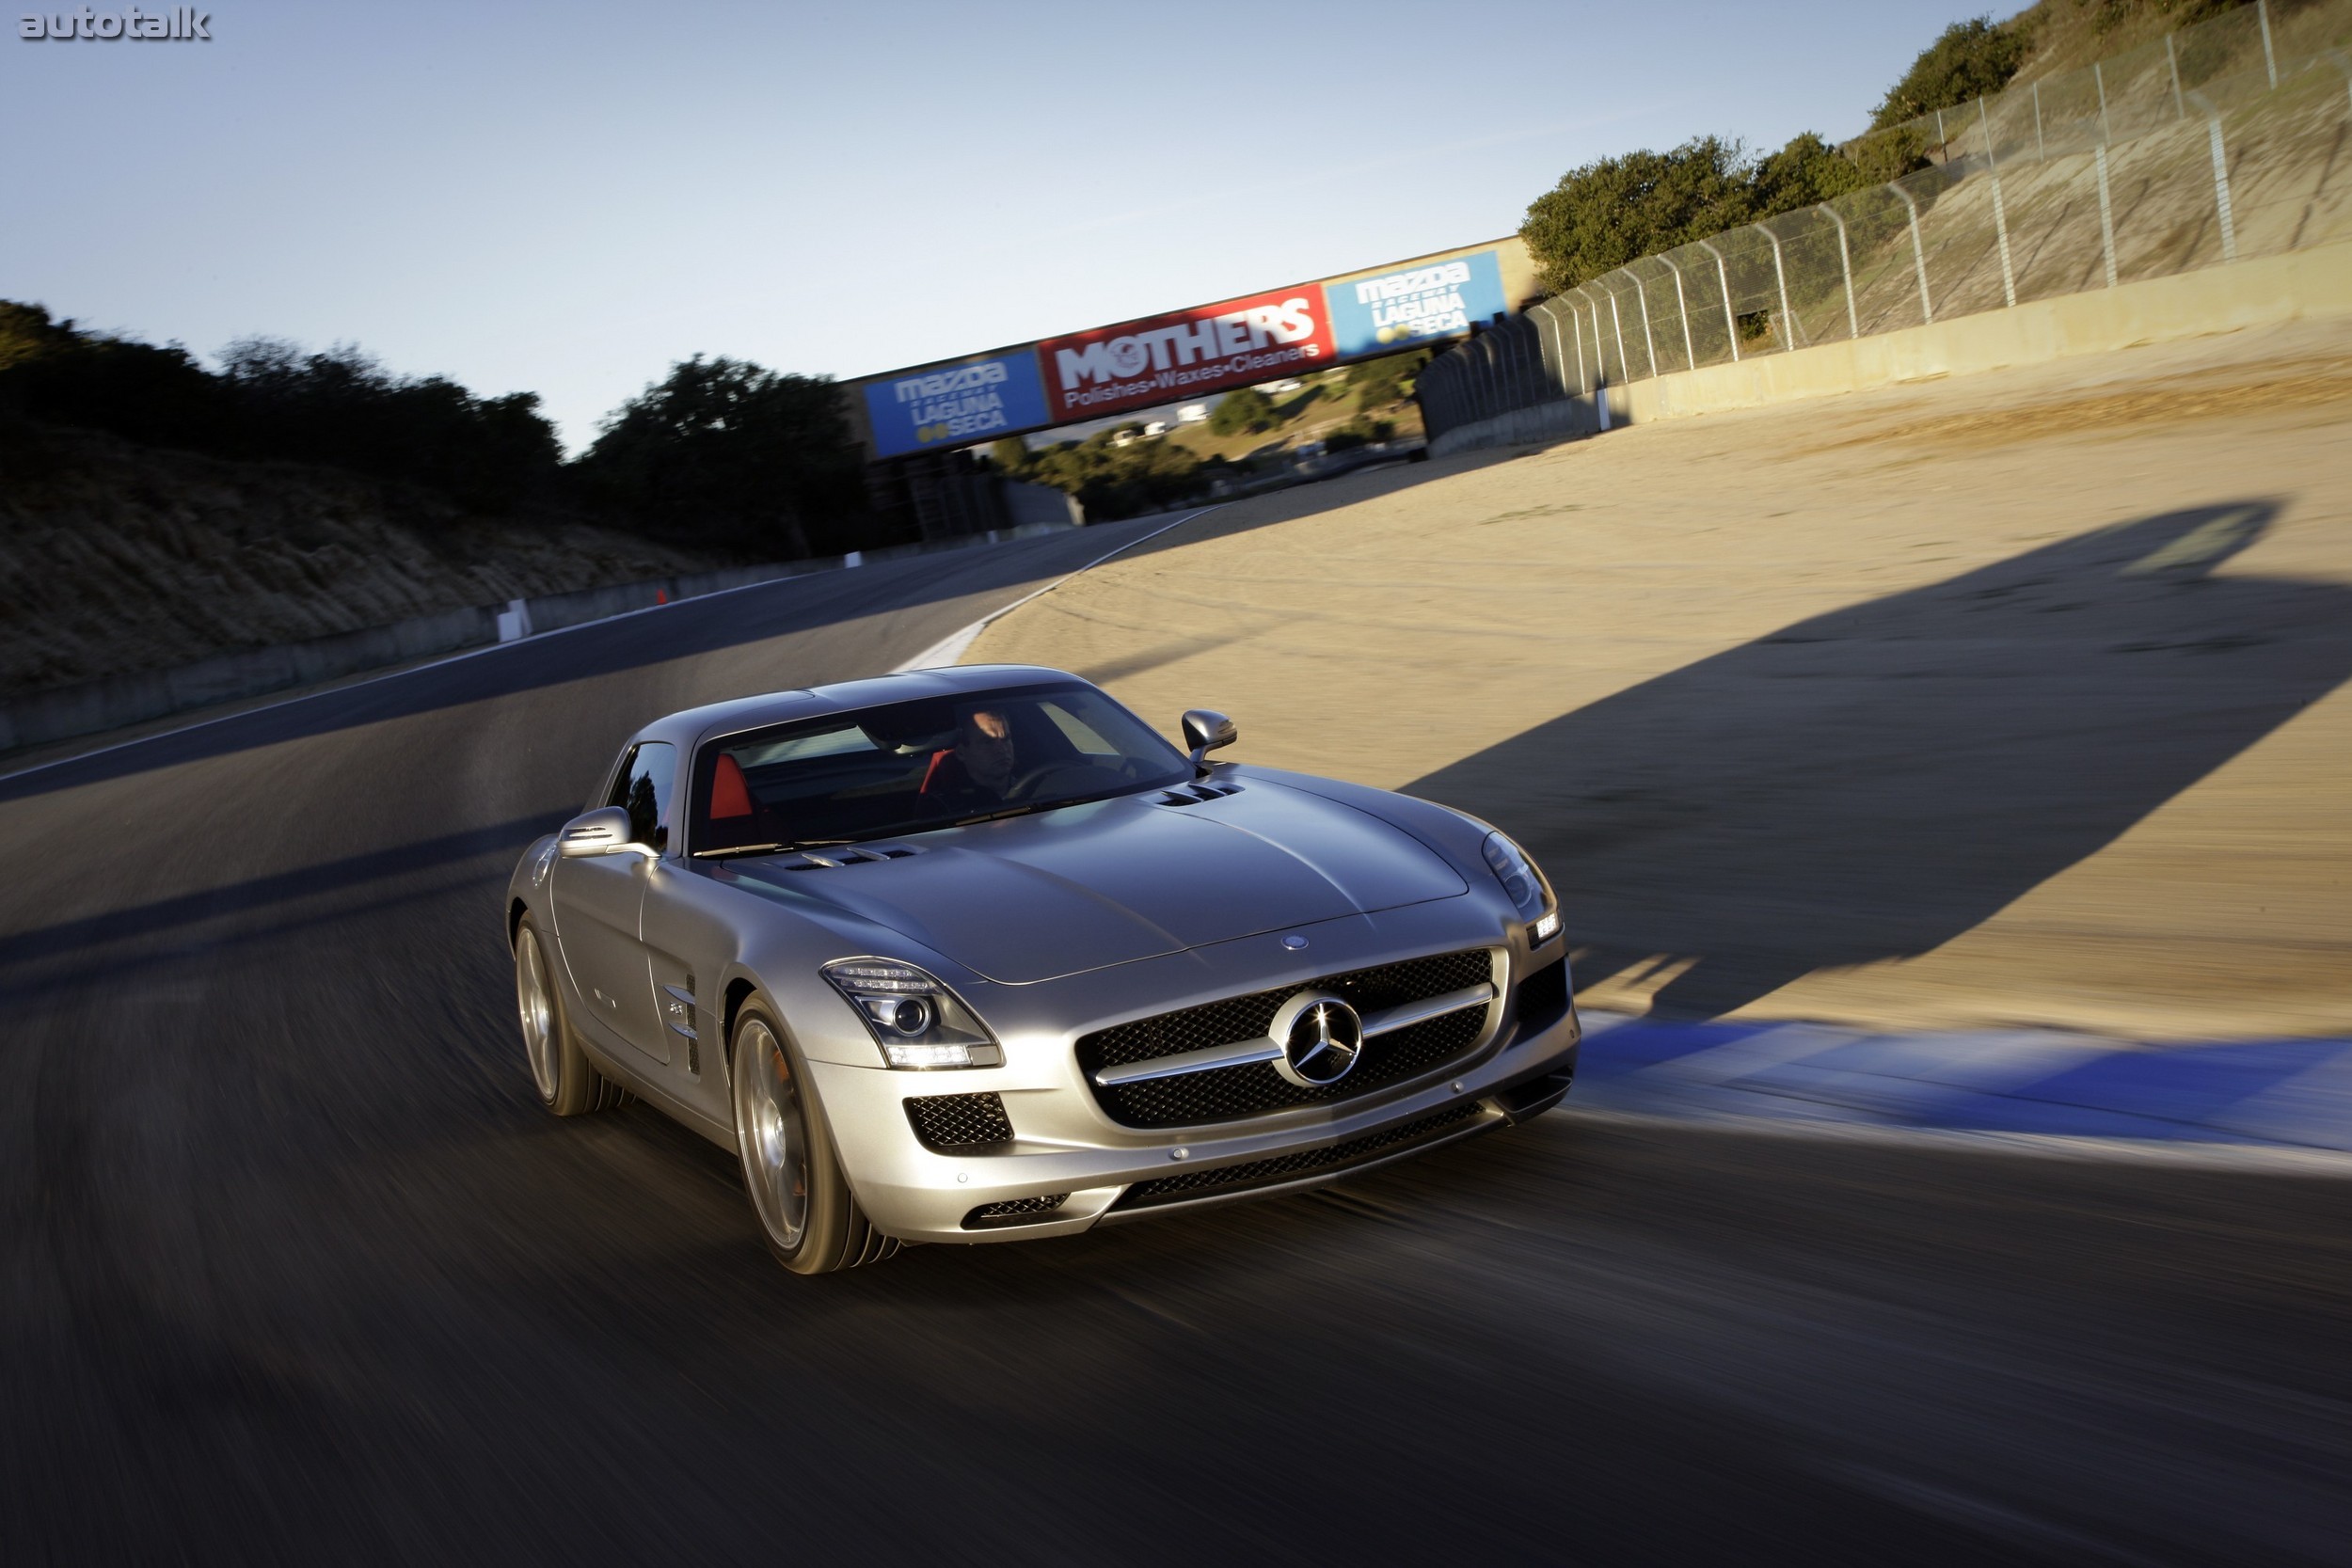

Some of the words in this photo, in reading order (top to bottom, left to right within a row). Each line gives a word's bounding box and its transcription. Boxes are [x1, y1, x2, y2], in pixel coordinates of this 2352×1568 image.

[1372, 293, 1466, 327] LAGUNA
[1408, 309, 1470, 337] SECA
[1055, 297, 1314, 390] MOTHERS
[911, 391, 1004, 426] LAGUNA
[947, 409, 1009, 436] SECA
